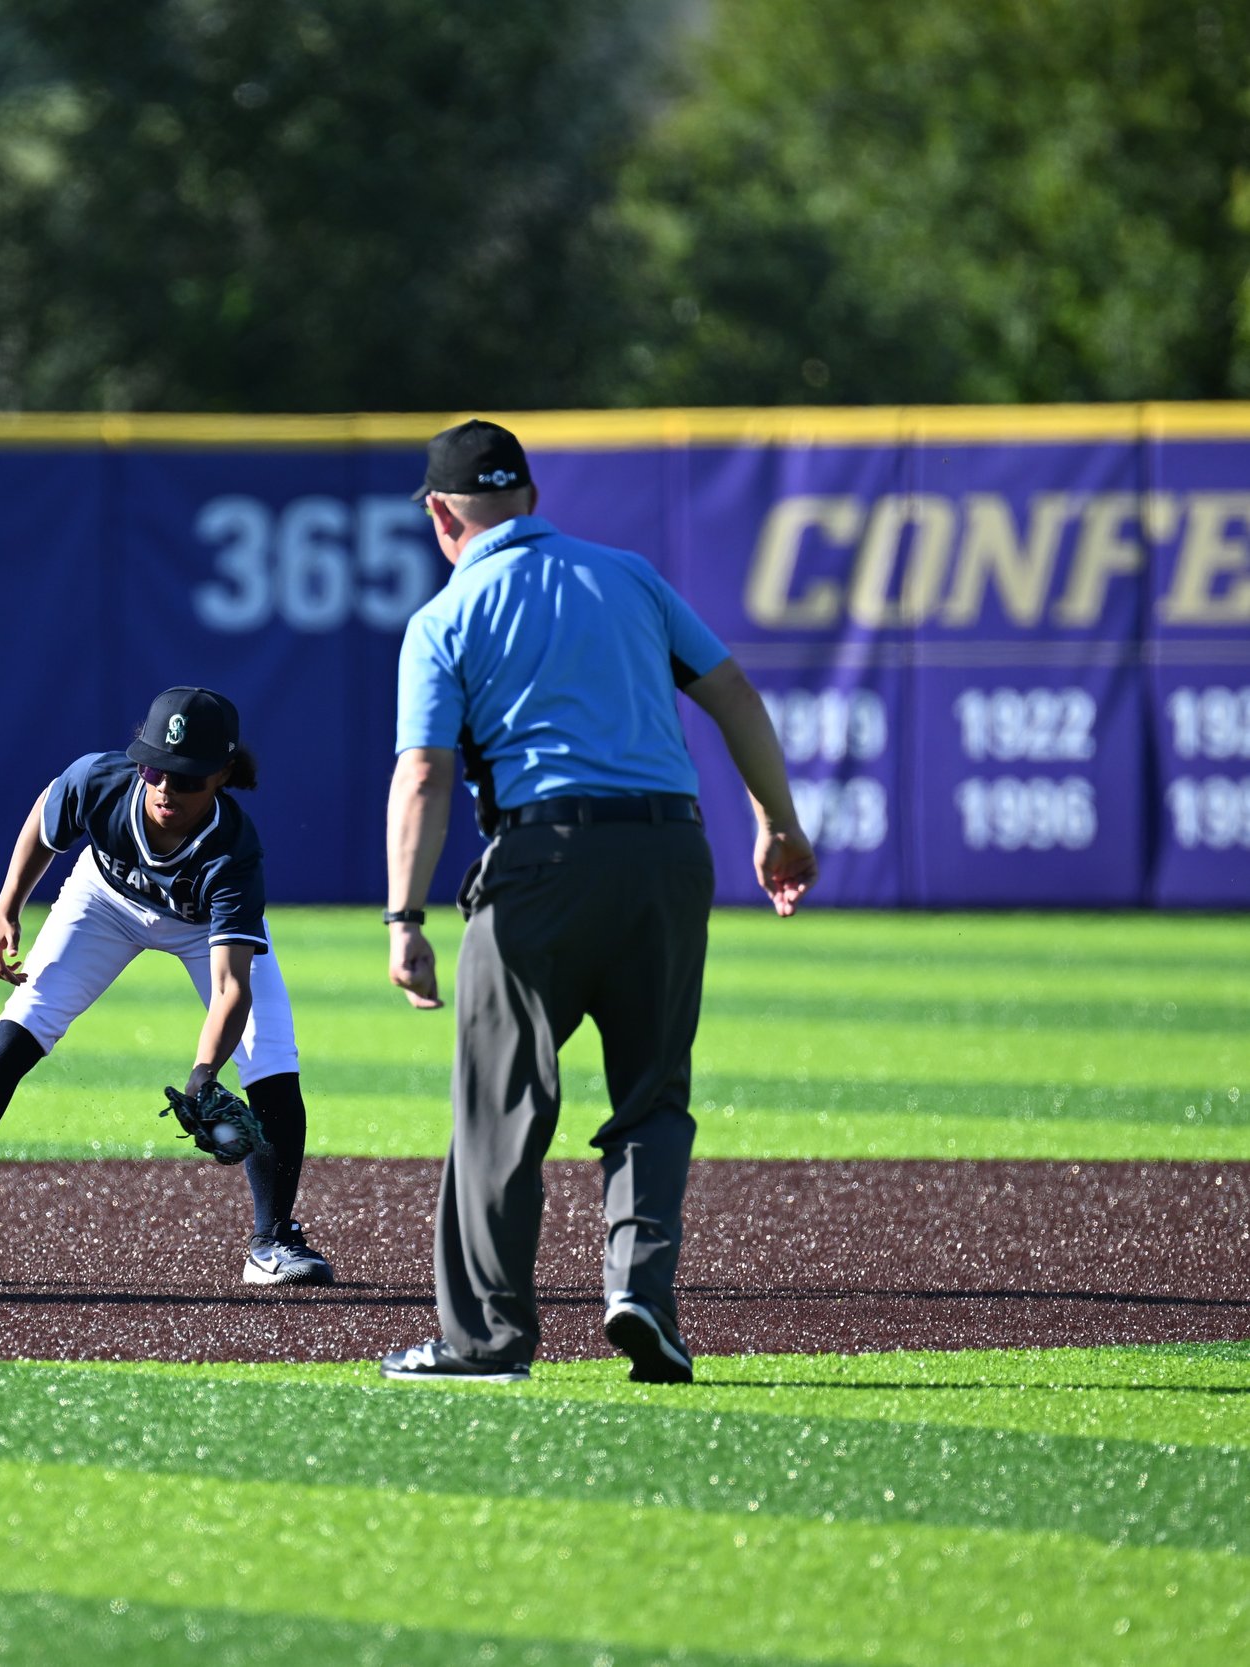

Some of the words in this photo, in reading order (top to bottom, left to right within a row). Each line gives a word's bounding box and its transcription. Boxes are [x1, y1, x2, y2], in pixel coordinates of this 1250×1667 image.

[194, 496, 434, 632] 365
[746, 494, 1250, 630] CONFE
[956, 687, 1096, 762] 1922
[790, 777, 888, 851] 993
[956, 777, 1097, 851] 1996
